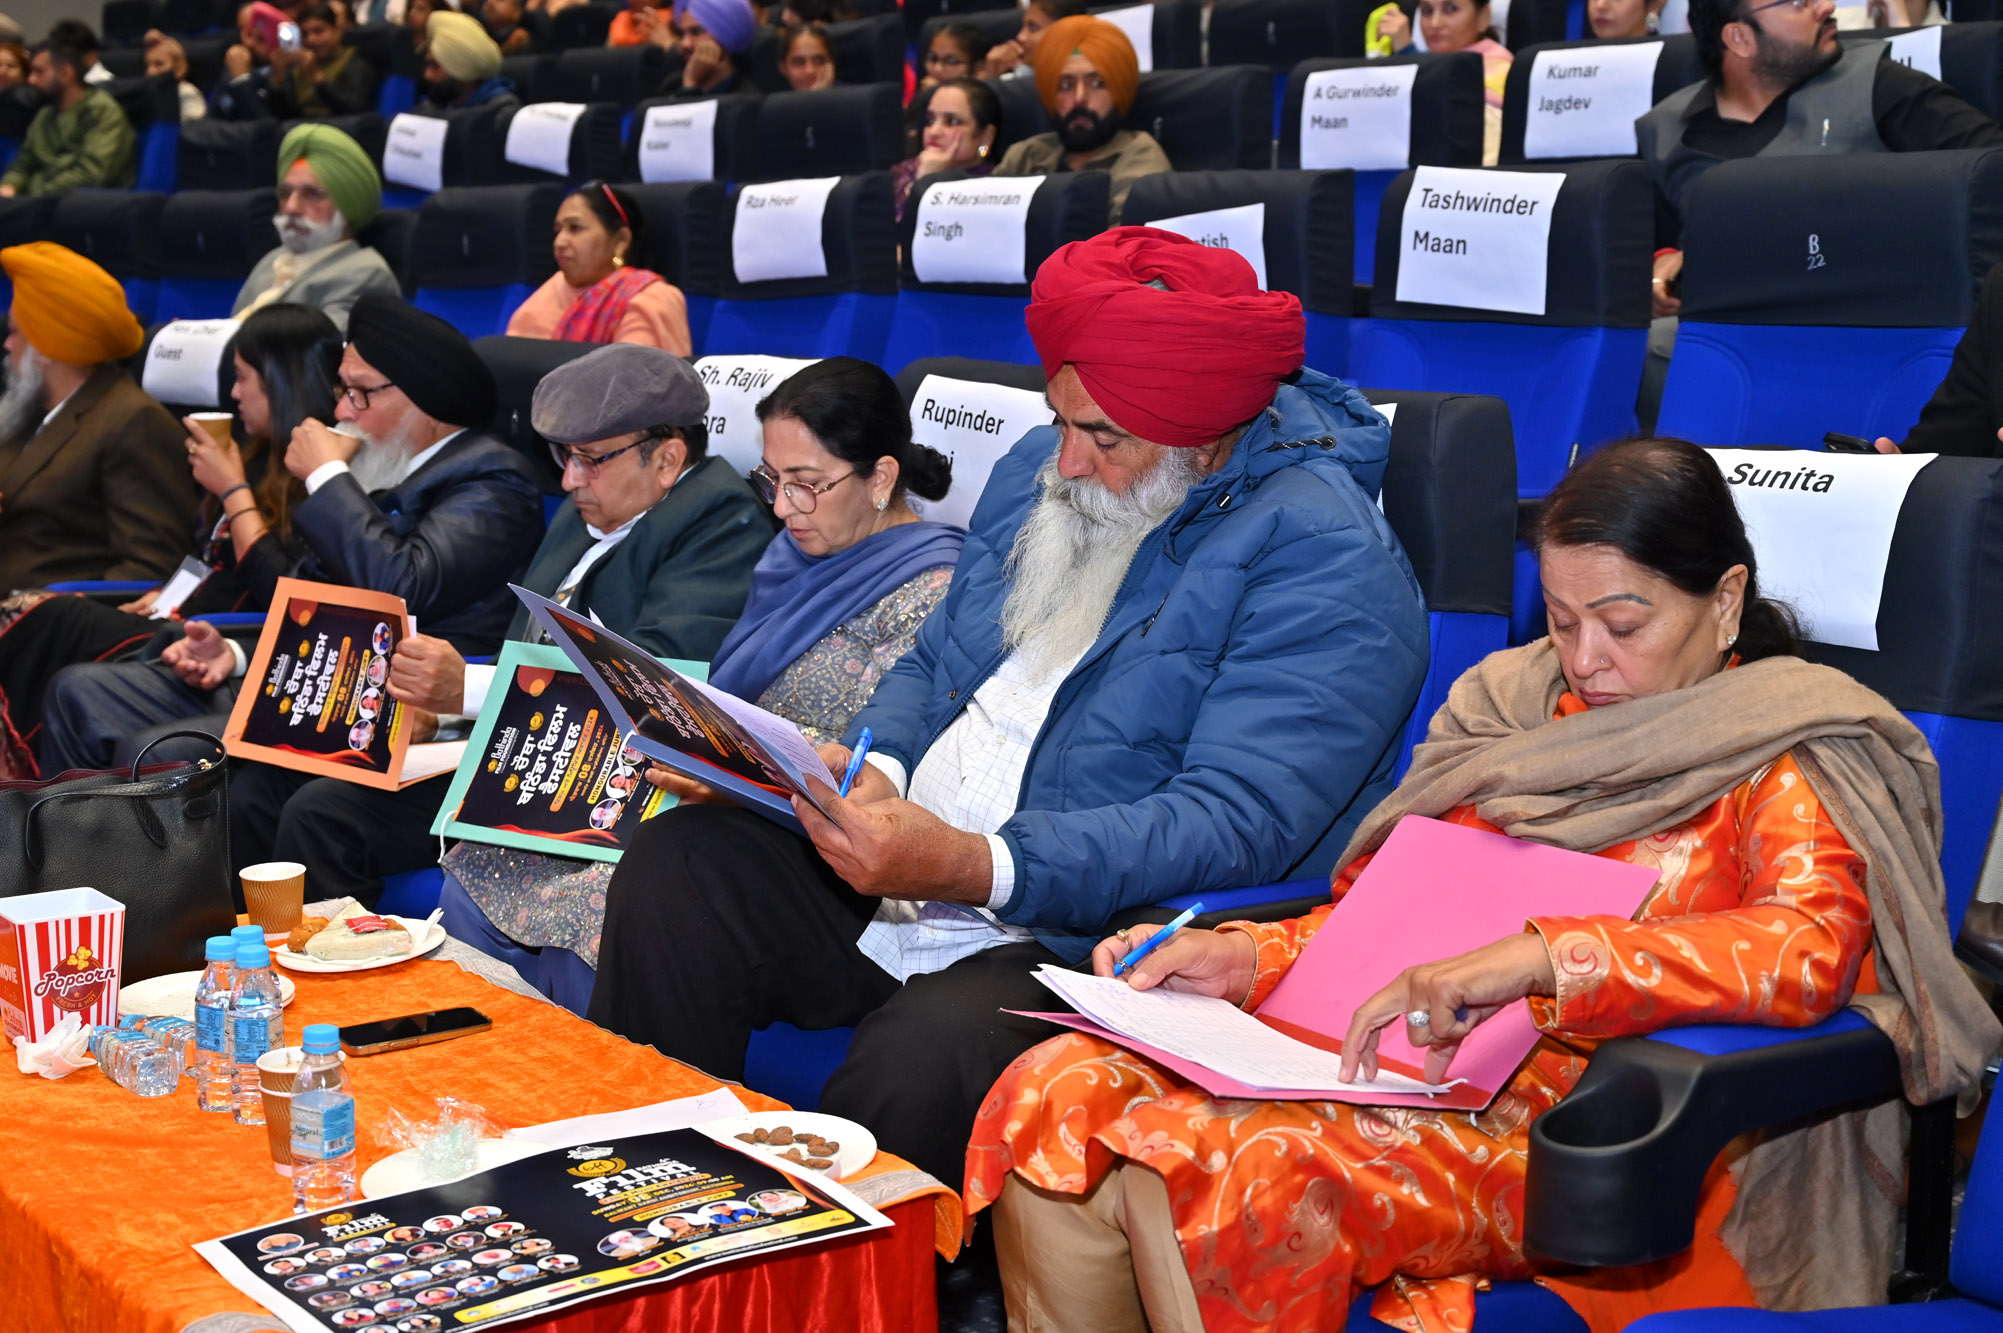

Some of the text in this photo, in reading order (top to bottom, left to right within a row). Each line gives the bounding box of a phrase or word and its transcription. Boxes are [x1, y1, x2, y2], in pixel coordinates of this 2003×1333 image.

[1547, 64, 1599, 79] Kumar
[1313, 83, 1400, 100] A Gurwinder
[1538, 95, 1592, 114] Jagdev
[1310, 115, 1348, 129] Maan
[947, 192, 1021, 206] Harsimran
[1421, 188, 1539, 216] Tashwinder
[923, 221, 963, 242] Singh
[1193, 232, 1229, 249] tish
[1412, 230, 1467, 255] Maan
[1809, 233, 1820, 254] B
[1807, 253, 1826, 270] 22
[154, 345, 183, 360] Guest
[700, 365, 775, 393] Sh. Rajiv
[921, 398, 1005, 436] Rupinder
[1727, 463, 1835, 493] Sunita
[584, 715, 594, 732] 2024
[491, 726, 512, 759] Bathinda
[511, 734, 537, 771] ਚੌਥਾ
[516, 703, 568, 806] ਬਠਿੰਡਾ ਫਿਲਮ
[538, 722, 582, 795] ਫੈਸਟੀਵਲ
[577, 763, 592, 779] 08
[589, 749, 615, 800] HONOURABLE
[34, 968, 116, 997] Popcorn
[56, 996, 76, 1009] FRESH
[84, 993, 97, 1005] HOT
[572, 1163, 697, 1197] Film
[595, 1171, 701, 1199] FESTIVAL
[591, 1200, 627, 1216] SUNDAY
[628, 1193, 652, 1204] 08
